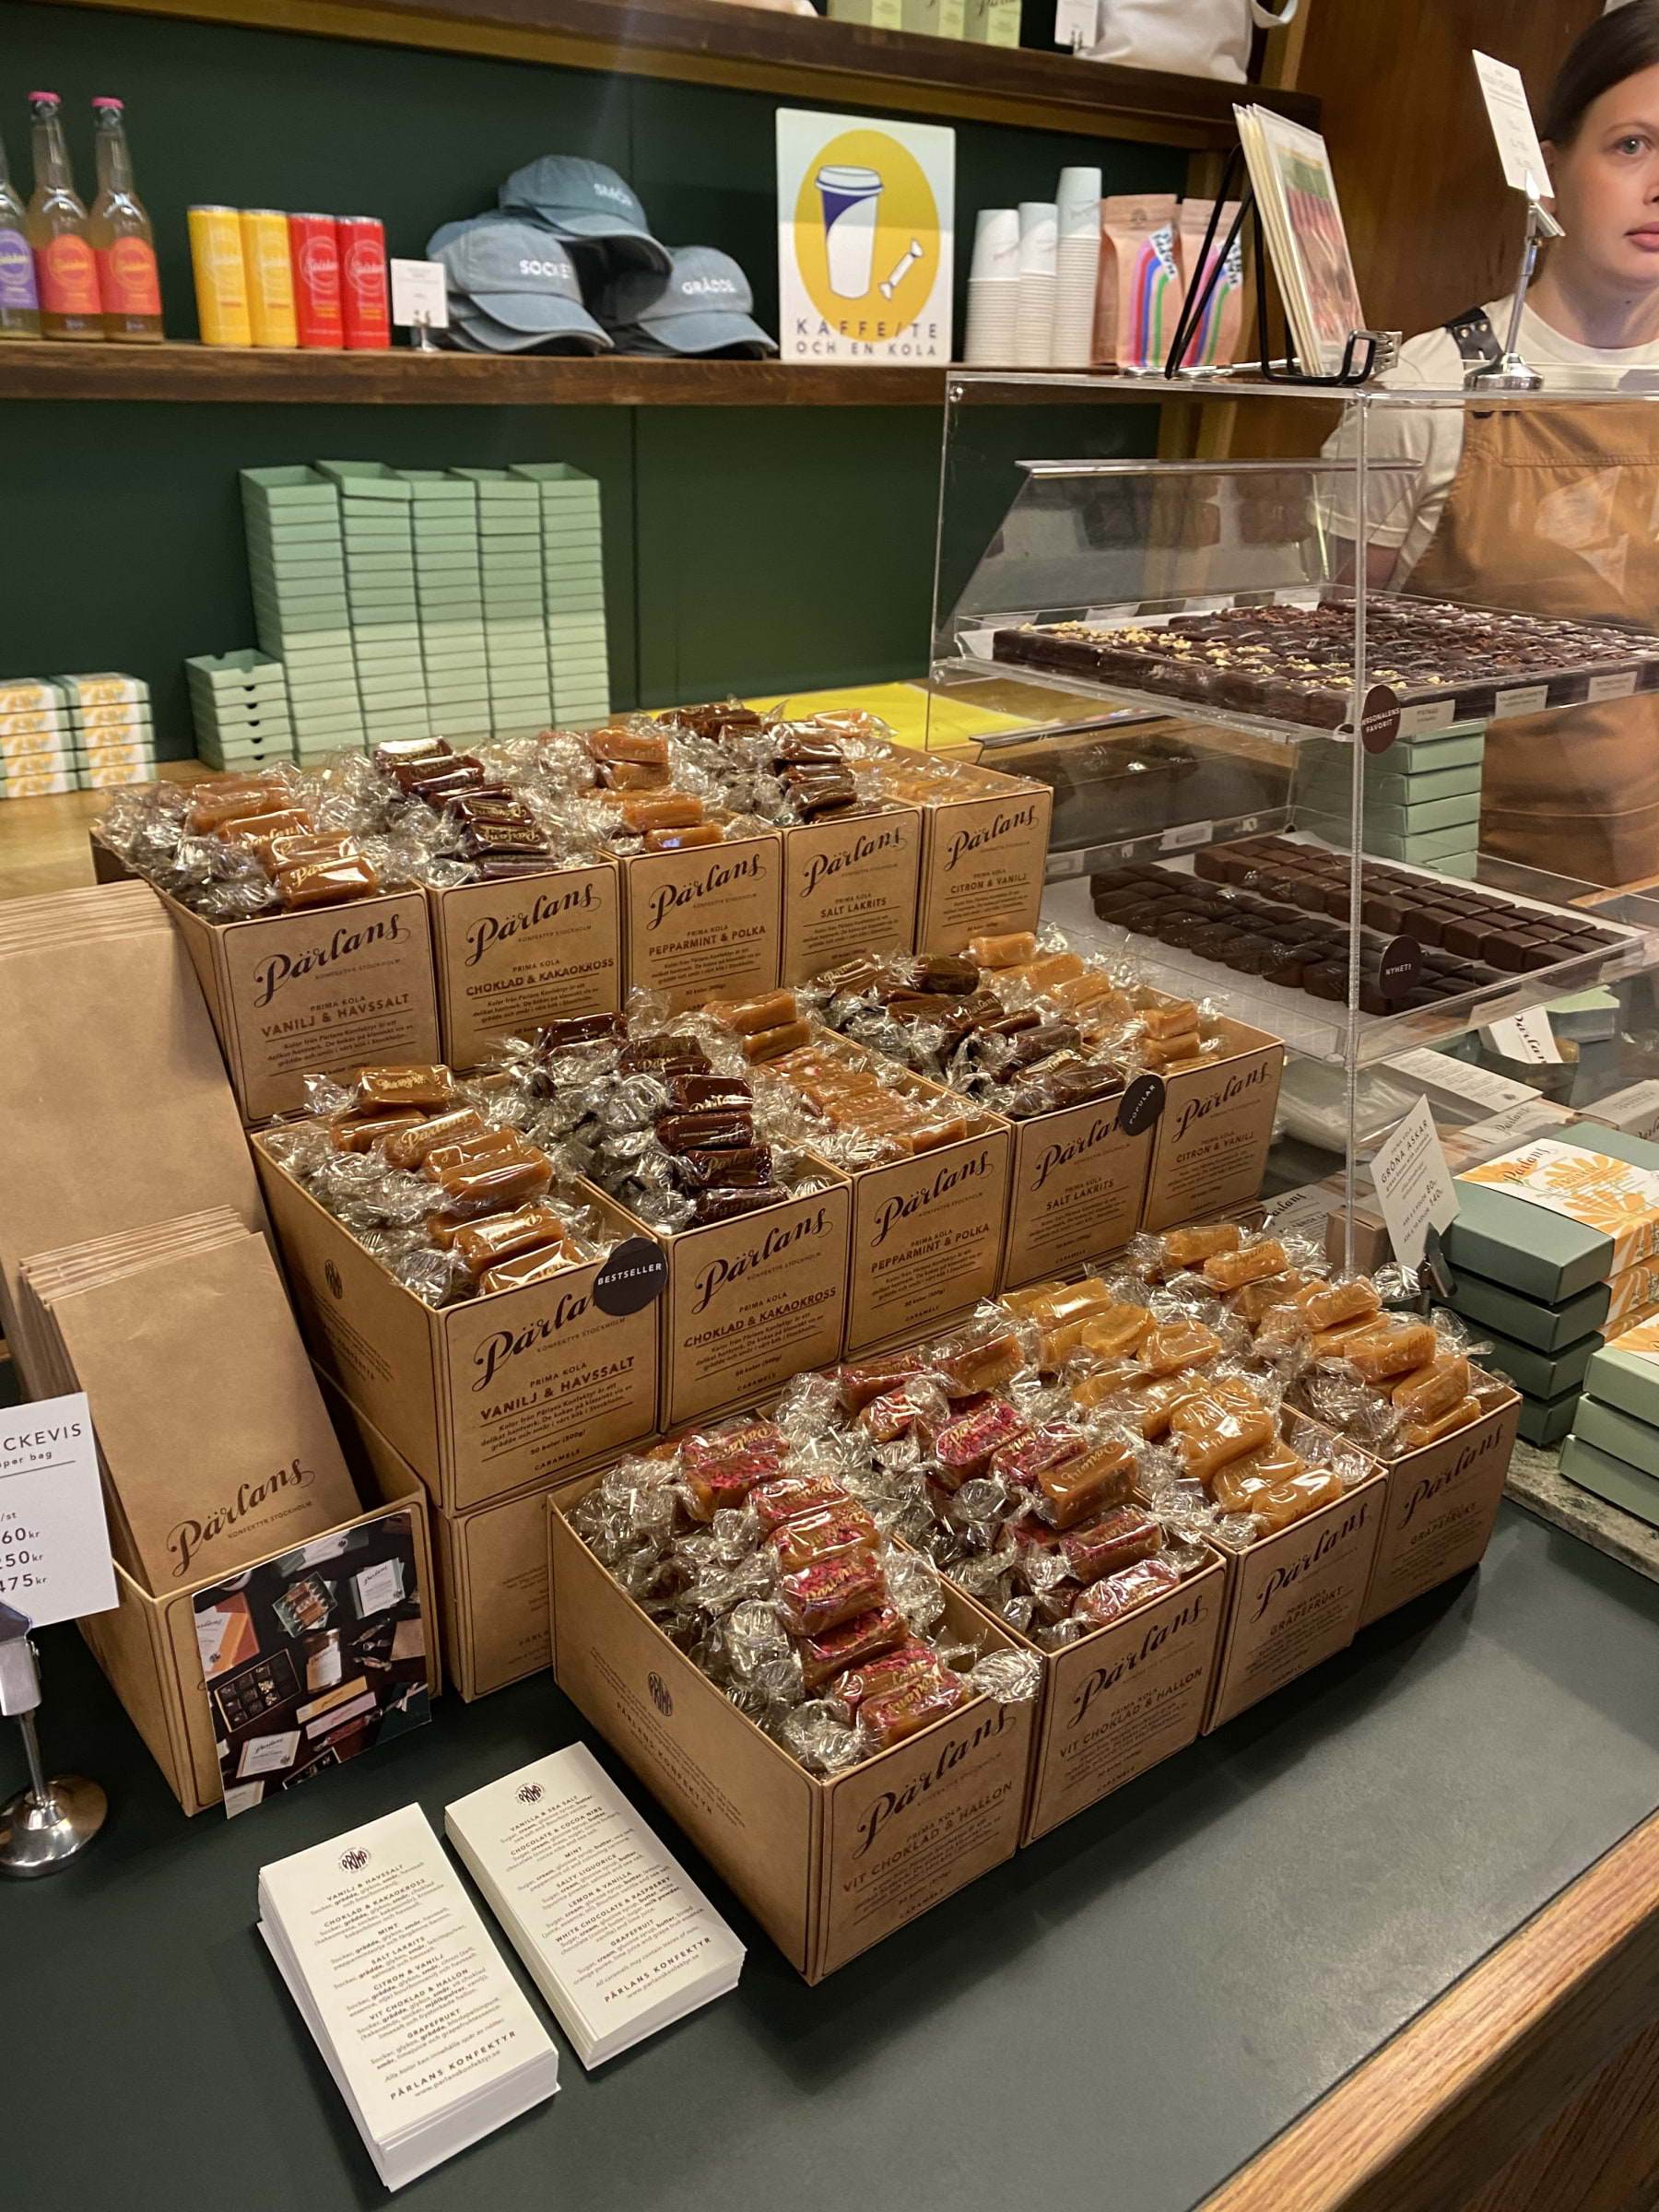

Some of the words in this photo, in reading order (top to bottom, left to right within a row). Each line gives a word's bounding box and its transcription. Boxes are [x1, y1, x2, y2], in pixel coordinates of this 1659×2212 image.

[796, 319, 936, 338] KAFFE/TE
[796, 341, 835, 354] OCH
[852, 343, 874, 354] EN
[888, 344, 935, 355] KOLA
[1366, 719, 1393, 733] FAVORIT
[944, 806, 1040, 871] Pärlans
[646, 853, 766, 931] Pärlans
[951, 881, 984, 894] CITRON
[996, 874, 1027, 886] VANILJ
[465, 884, 602, 966] Pärlans
[820, 907, 843, 918] SALT
[848, 897, 887, 913] LAKRITS
[649, 935, 717, 957] PEPPARMINT
[732, 924, 766, 940] POLKA
[253, 914, 410, 1007] Pärlans
[466, 977, 524, 996] CHOKLAD
[539, 959, 614, 982] KAKAOKROSS
[1386, 962, 1412, 975] NYHET!
[262, 1015, 315, 1037] VANILJ
[338, 994, 409, 1018] HAVSSALT
[1129, 1085, 1156, 1124] POPULAR
[1171, 1062, 1272, 1143] Pärlans
[1176, 1146, 1210, 1163] CITRON
[1224, 1131, 1253, 1147] VANILJ
[1382, 1150, 1405, 1183] GRÖNA
[1407, 1120, 1428, 1148] ASKAR
[1500, 1147, 1559, 1187] Pärlans
[871, 1151, 994, 1248] Pärlans
[1047, 1194, 1070, 1210] SALT
[1074, 1178, 1114, 1201] LAKRITS
[871, 1241, 940, 1273] PEPPARMINT
[955, 1223, 990, 1242] POLKA
[911, 1236, 933, 1247] PRIMA
[935, 1229, 953, 1239] KOLA
[597, 1263, 662, 1286] BESTSELLER
[691, 1207, 833, 1315] Pärlans
[683, 1320, 744, 1348] CHOKLAD
[759, 1287, 836, 1323] KAKAOKROSS
[739, 1300, 764, 1313] PRIMA
[767, 1291, 788, 1304] KOLA
[536, 1335, 580, 1353] KONFEKTYR
[582, 1317, 626, 1336] STOCKHOLM
[480, 1393, 538, 1421] VANILJ
[544, 1388, 554, 1400] &
[560, 1356, 634, 1393] HAVSSALT
[530, 1372, 559, 1388] PRIMA
[562, 1361, 587, 1376] KOLA
[29, 1452, 52, 1461] bag
[535, 1449, 581, 1471] CARAMELS
[166, 1457, 315, 1578] Pärlans
[227, 1516, 269, 1539] KONFEKTYR
[270, 1500, 312, 1524] STOCKHOLM
[1250, 1503, 1372, 1624] Pärlans
[1270, 1586, 1343, 1636] GRAPEFRUKT
[1067, 1594, 1208, 1729] Pärlans
[1060, 1740, 1079, 1759] VIT
[1083, 1705, 1139, 1746] CHOKLAD
[1157, 1666, 1203, 1701] HALLON
[518, 1785, 542, 1803] PRIMA
[852, 1705, 1016, 1860] Pärlans
[510, 1816, 539, 1831] VANILLA
[547, 1805, 561, 1813] SEA
[562, 1795, 578, 1806] SALT
[511, 1832, 551, 1855] CHOCOLATE
[560, 1816, 584, 1830] COCOA
[586, 1806, 603, 1817] NIBS
[907, 1821, 935, 1843] PRIMA
[938, 1806, 962, 1824] KOLA
[565, 1847, 582, 1859] MINT
[843, 1873, 866, 1893] VIT
[871, 1828, 939, 1877] CHOKLAD
[959, 1781, 1013, 1822] HALLON
[342, 1850, 368, 1870] PRIMA
[556, 1874, 577, 1888] SALTY
[579, 1854, 617, 1876] LIQUORICE
[326, 1886, 356, 1901] VANILJ
[366, 1865, 404, 1885] HAVSSALT
[568, 1891, 594, 1908] LEMON
[602, 1871, 632, 1889] VANILLA
[324, 1907, 362, 1927] CHOKLAD
[372, 1878, 426, 1905] KAKAOKROSS
[555, 1926, 580, 1943] WHITE
[581, 1902, 623, 1928] CHOCOLATE
[631, 1876, 671, 1900] RASPBERRY
[378, 1924, 398, 1936] MINT
[610, 1919, 654, 1947] GRAPEFRUIT
[371, 1953, 391, 1965] SALT
[393, 1936, 426, 1955] LAKRITS
[373, 1971, 405, 1991] CITRON
[415, 1954, 443, 1971] VANILJ
[605, 1971, 651, 2003] PÄRLANS
[653, 1937, 711, 1972] KONFEKTYR
[369, 2011, 382, 2020] VIT
[385, 1991, 426, 2013] CHOKLAD
[436, 1969, 469, 1988] HALLON
[407, 2008, 461, 2039] GRAPEFRUKT
[390, 2068, 444, 2100] PÄRLANS
[448, 2030, 516, 2070] KONFEKTYR
